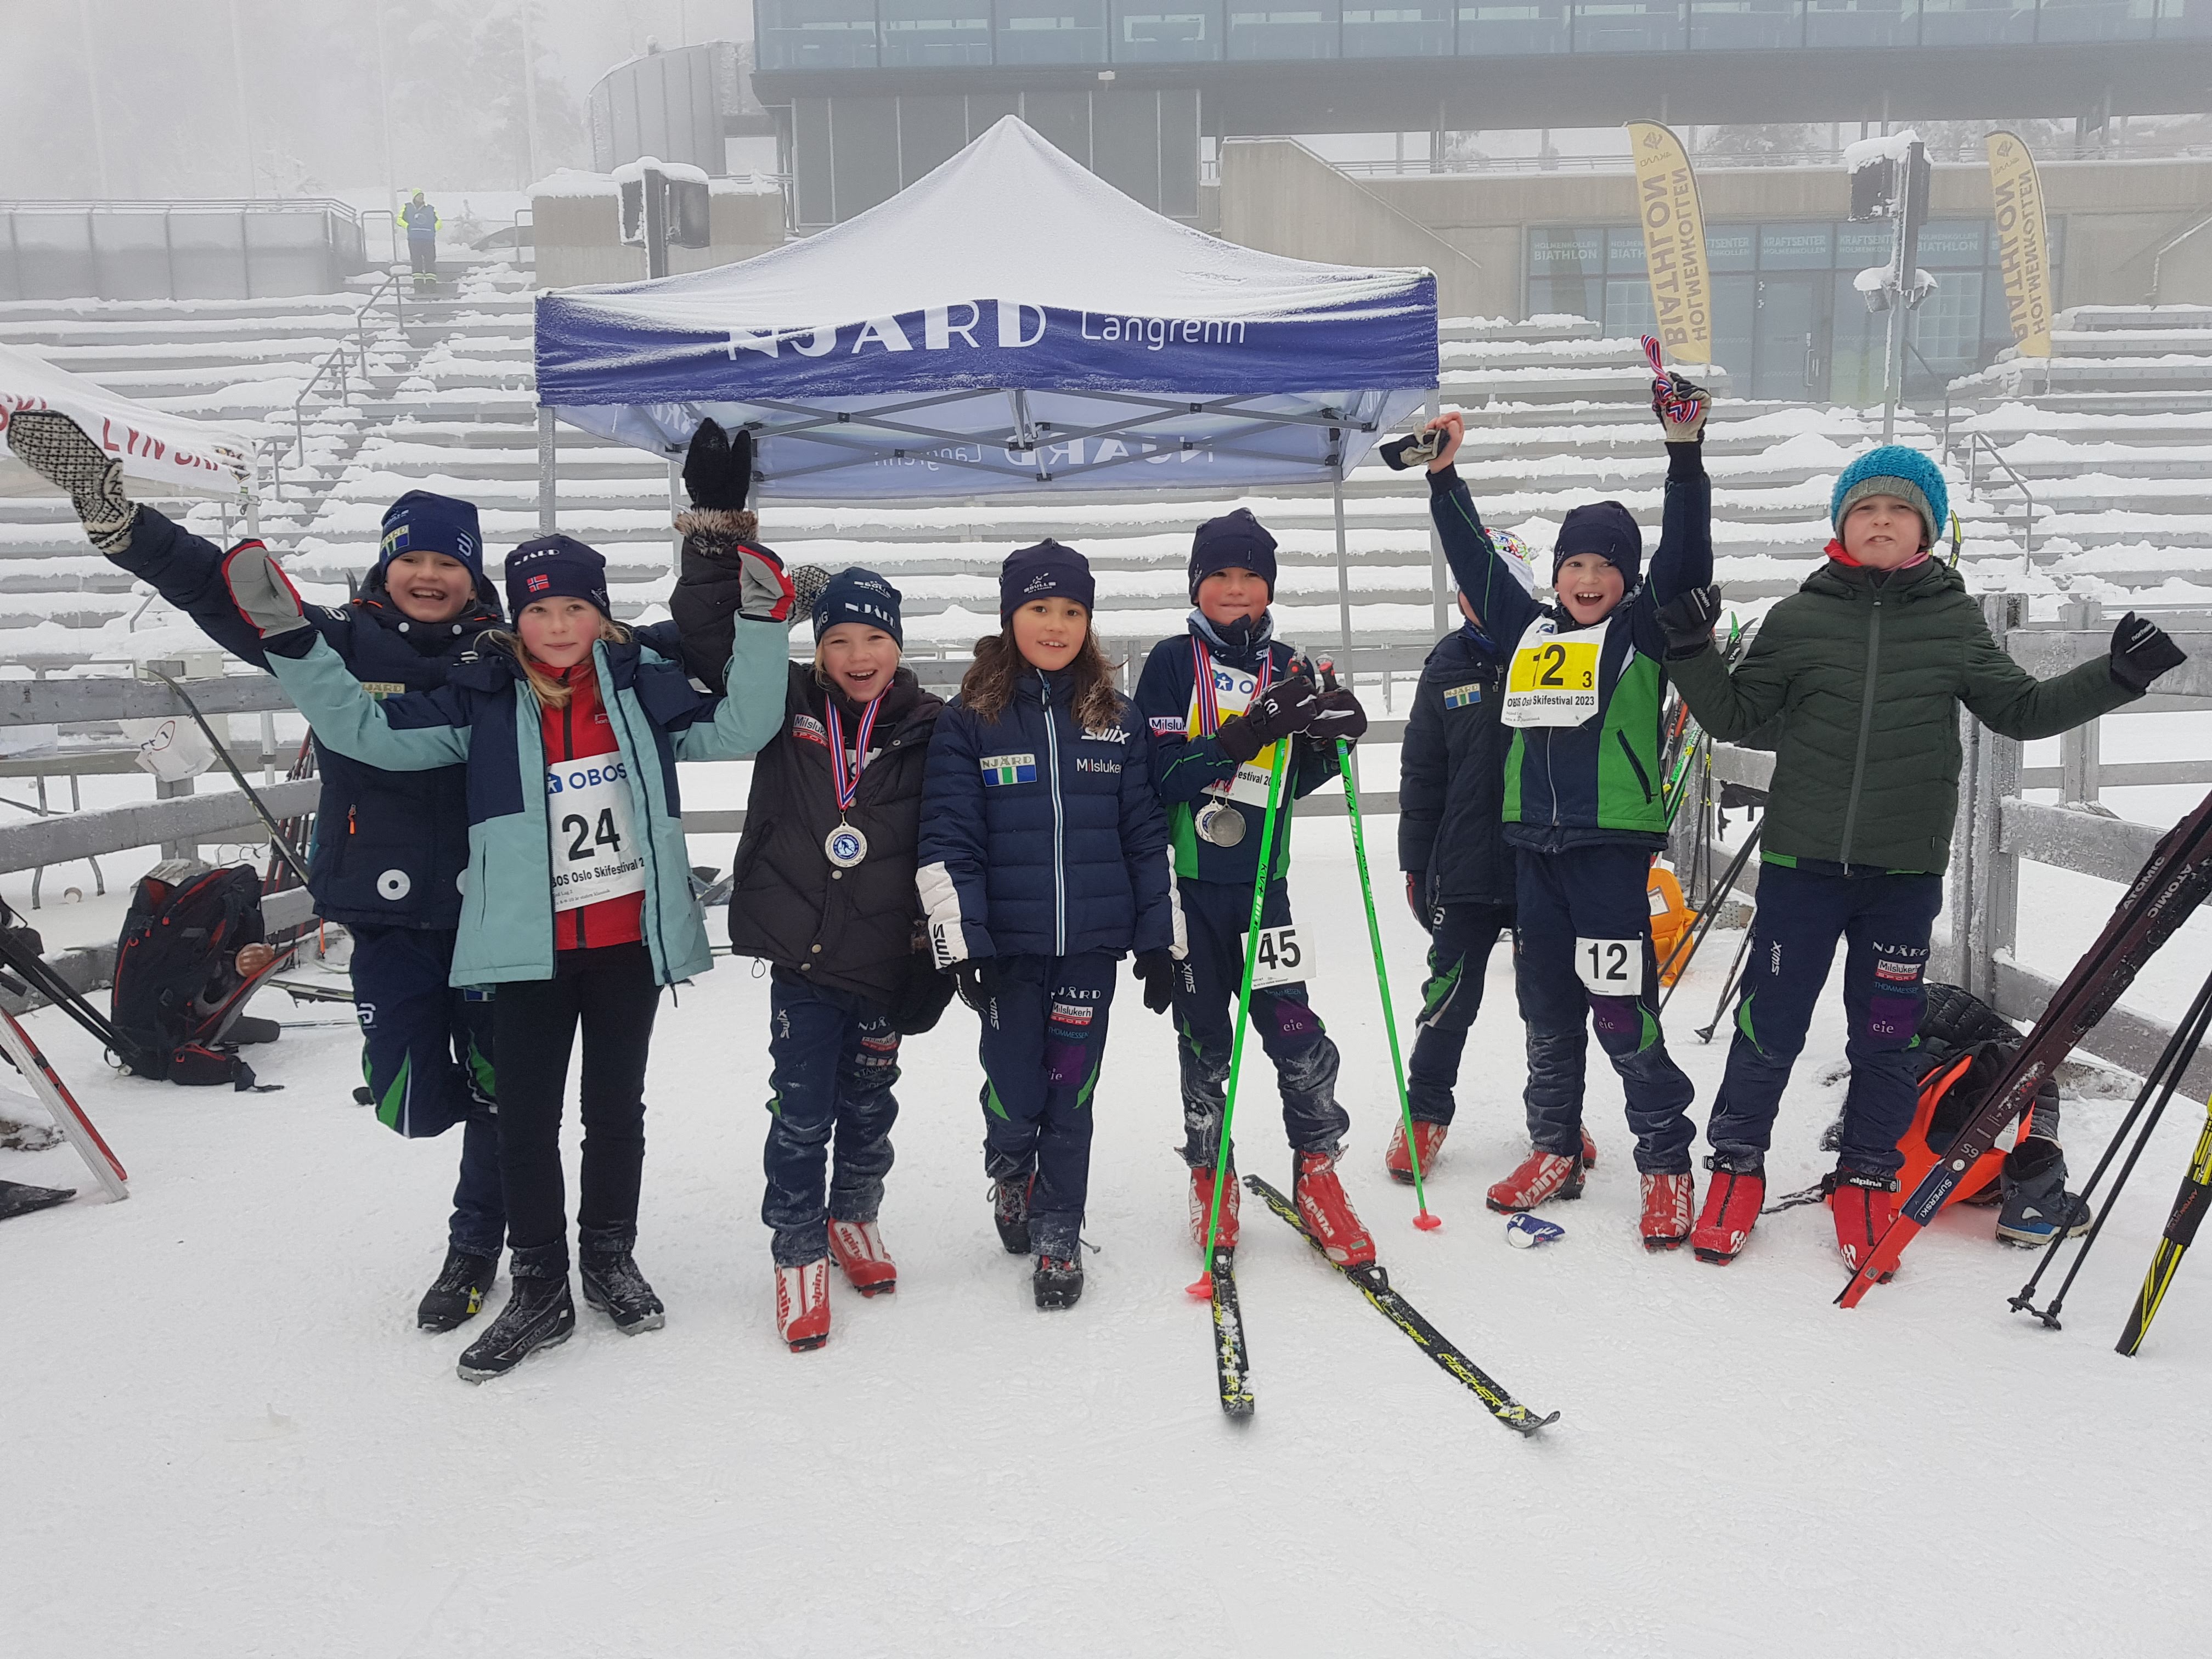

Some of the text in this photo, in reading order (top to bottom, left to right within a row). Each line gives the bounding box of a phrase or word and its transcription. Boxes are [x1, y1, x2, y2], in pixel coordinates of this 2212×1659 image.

[1534, 249, 1598, 261] BIATHLON
[1763, 235, 1826, 246] KRAFTSENTER
[1081, 311, 1245, 351] Langrenn
[1582, 670, 1592, 688] 3
[1533, 695, 1573, 705] Skifestival
[1575, 696, 1594, 706] 2023
[1081, 725, 1131, 744] swix
[569, 763, 627, 789] OBOS
[982, 755, 1032, 768] NJÅRD
[562, 807, 620, 861] 24
[572, 870, 592, 883] Oslo
[595, 858, 637, 878] Skifestival
[2123, 856, 2165, 910] ATOMIC
[2147, 863, 2192, 918] ATOMIC
[1258, 929, 1301, 970] 45
[1588, 943, 1628, 980] 12
[1771, 940, 1782, 976] swix
[1181, 962, 1196, 994] swix
[990, 996, 1000, 1030] swix
[1283, 1019, 1304, 1032] eie
[1872, 1020, 1894, 1034] eie
[1849, 1177, 1882, 1188] alpina
[1920, 1178, 1953, 1218] SUPERSKI
[812, 1264, 823, 1308] alpina
[1437, 1353, 1503, 1406] FISCHER
